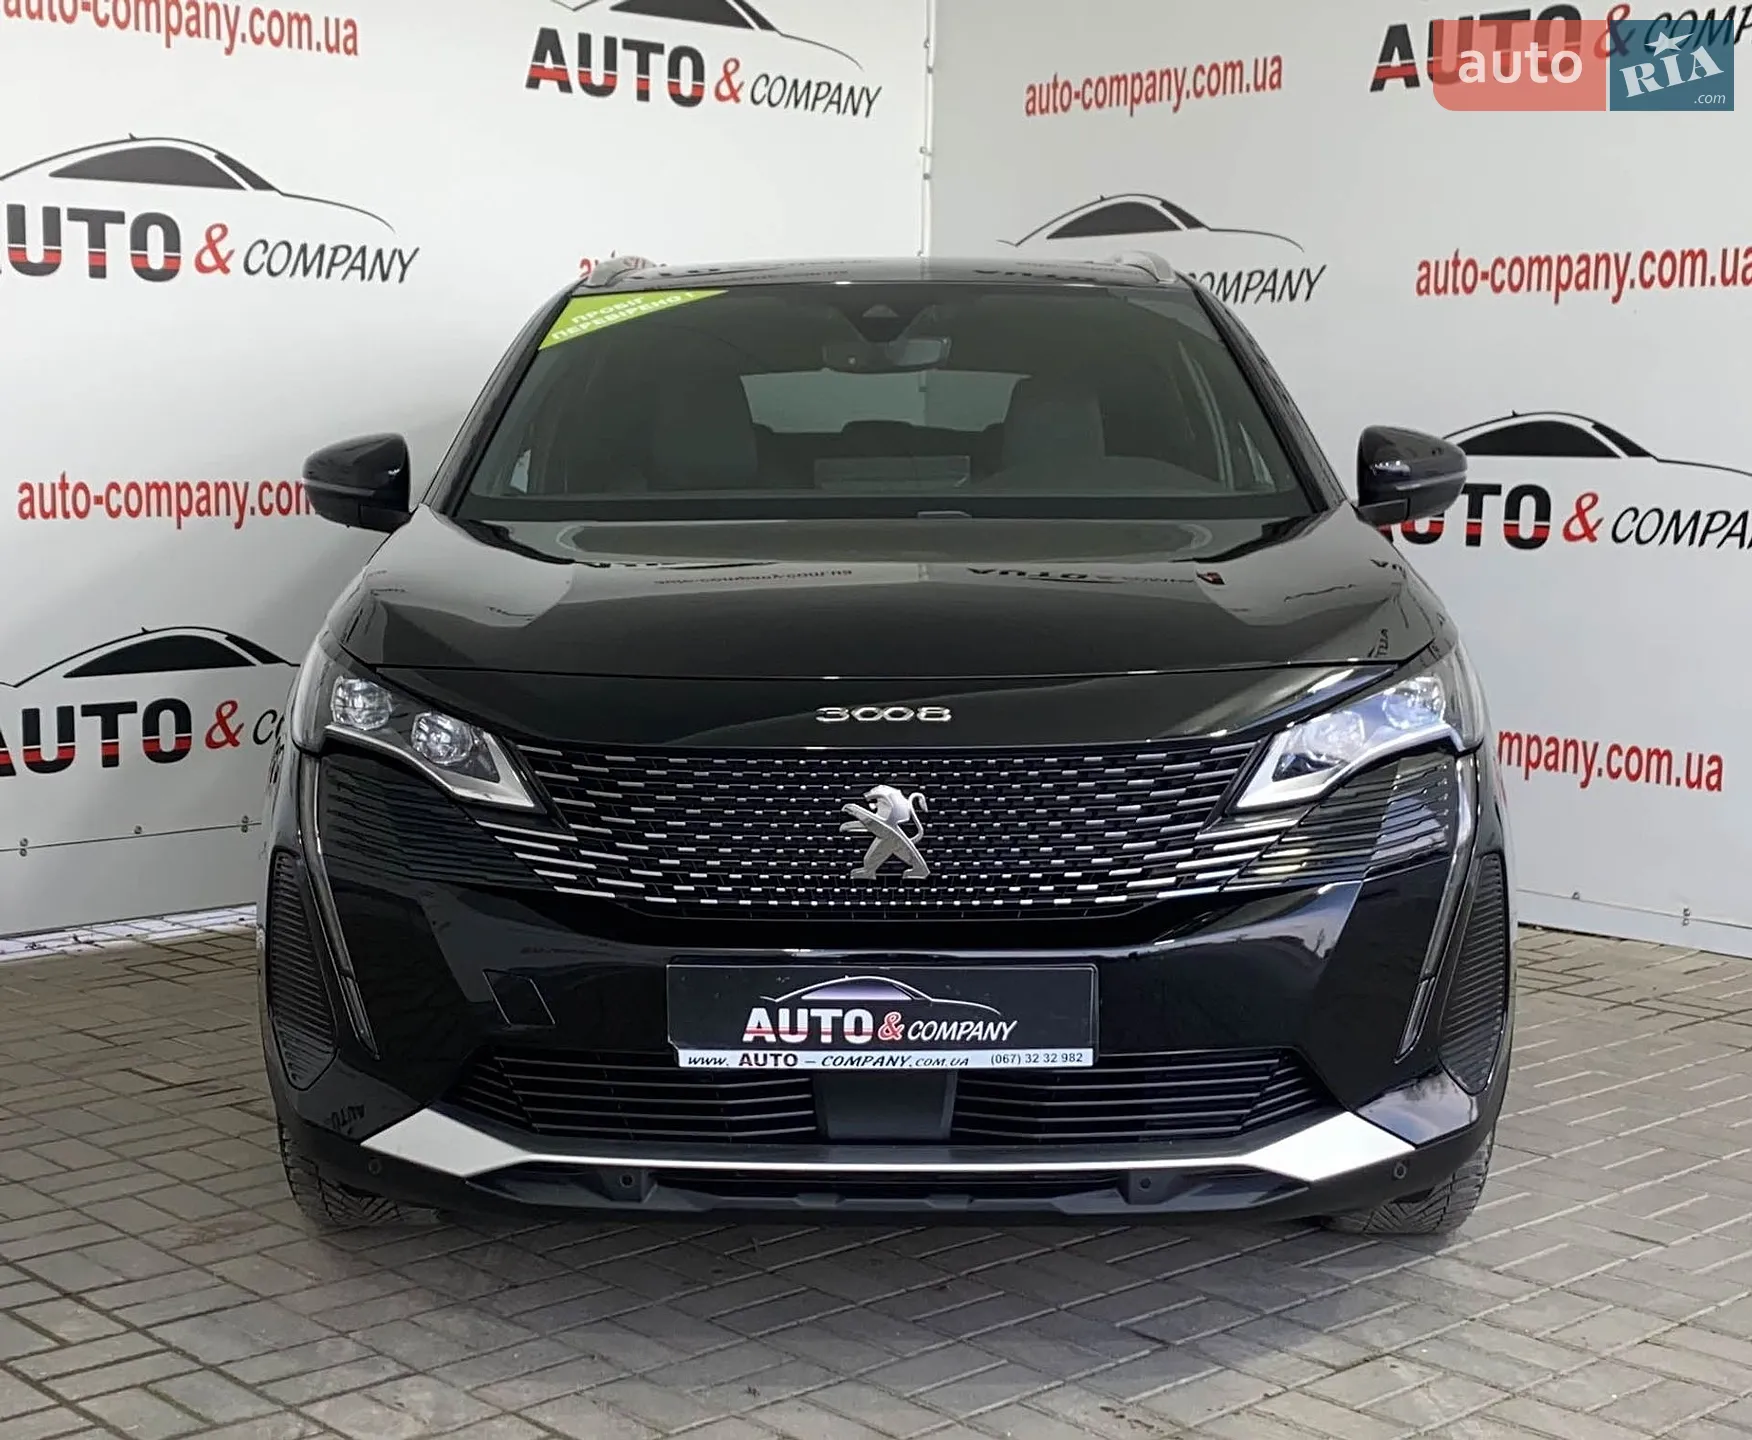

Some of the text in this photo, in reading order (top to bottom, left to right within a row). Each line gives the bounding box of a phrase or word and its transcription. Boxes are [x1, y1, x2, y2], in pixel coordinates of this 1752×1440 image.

[525, 27, 882, 118] AUTO & COMPANY
[1025, 54, 1283, 118] auto-company.com.ua
[0, 203, 419, 284] UTO & COMPANY
[1562, 492, 1604, 543] &
[1611, 506, 1752, 550] COMPA
[204, 700, 244, 751] &
[815, 706, 952, 723] 3008
[742, 1007, 1018, 1044] AUTO & COMPANY
[738, 1053, 798, 1067] AUTO
[990, 1052, 1083, 1066] (067) 32 32 982
